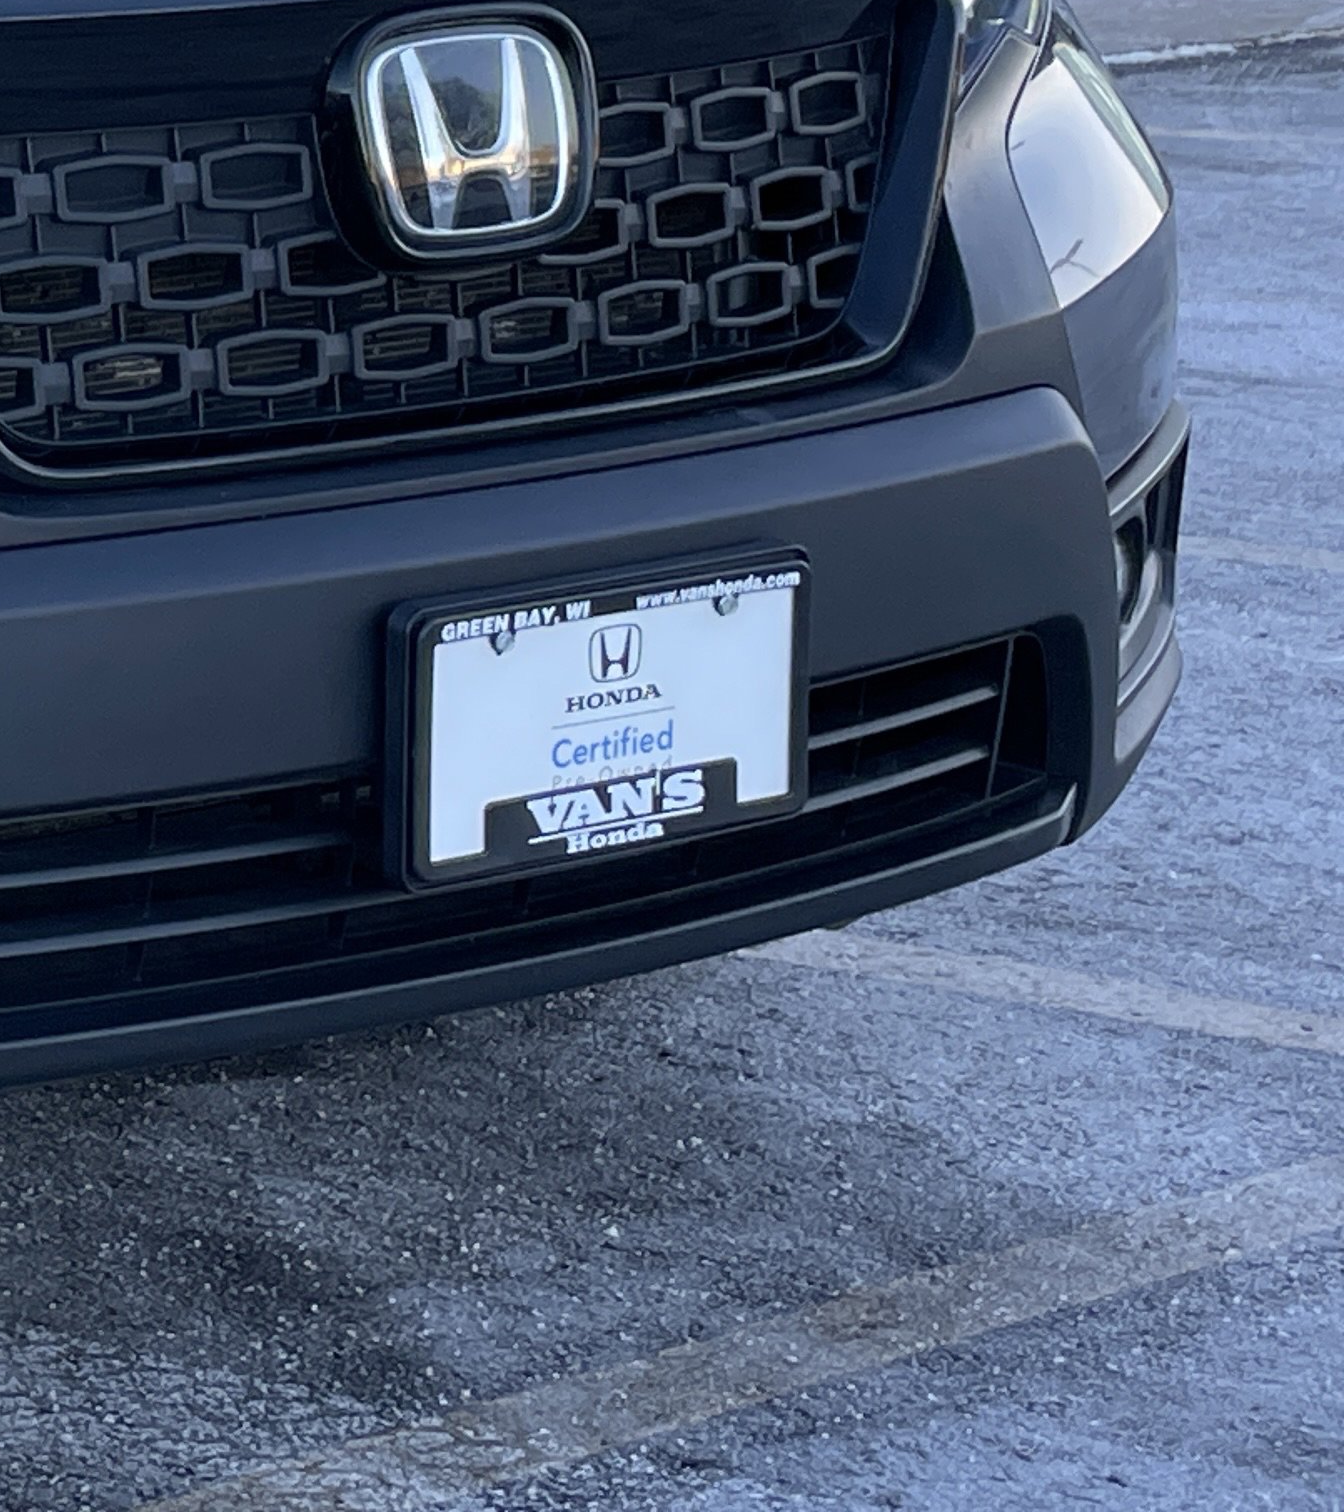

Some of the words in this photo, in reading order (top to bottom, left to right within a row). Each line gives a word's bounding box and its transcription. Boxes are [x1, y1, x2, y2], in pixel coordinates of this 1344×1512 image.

[635, 570, 801, 611] www.vanshonda.com
[440, 613, 510, 643] GREEN
[565, 599, 592, 621] WI
[564, 683, 663, 714] HONDA
[551, 718, 674, 769] Certified
[566, 821, 665, 855] Honda
